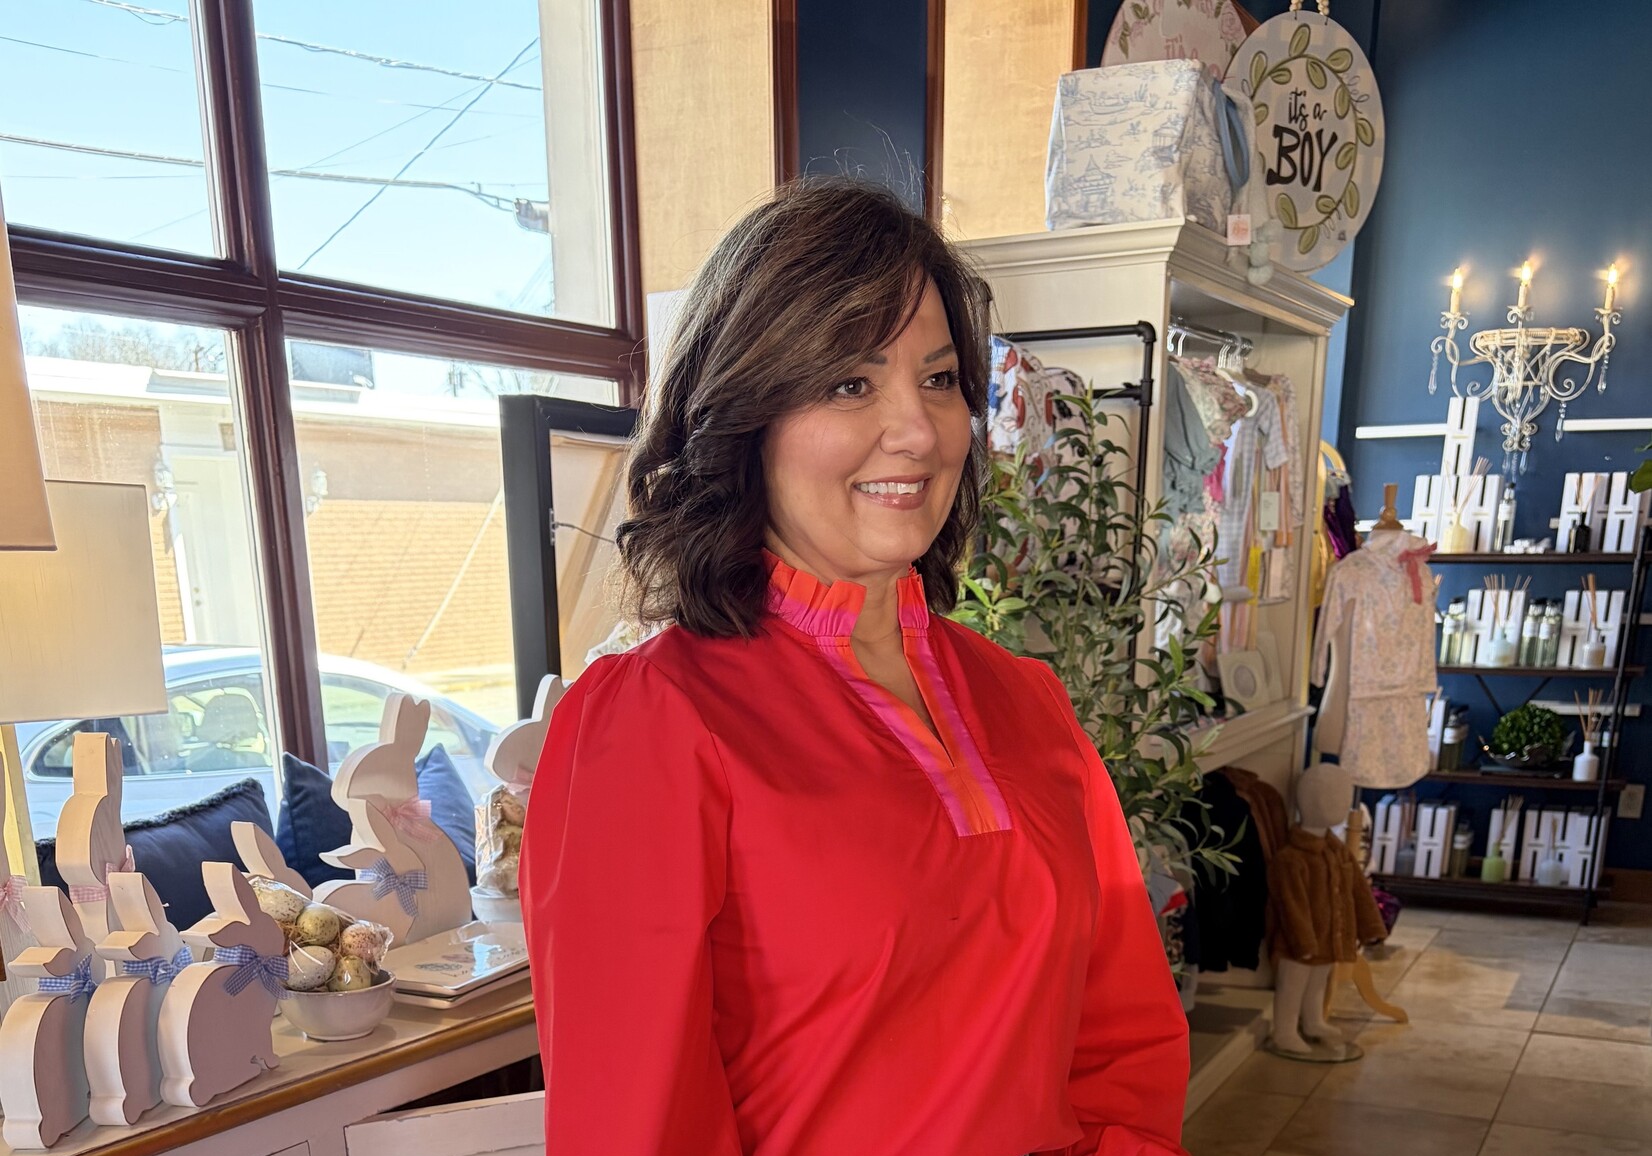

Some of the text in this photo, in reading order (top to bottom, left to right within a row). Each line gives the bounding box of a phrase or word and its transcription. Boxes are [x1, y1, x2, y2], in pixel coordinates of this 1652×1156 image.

[1288, 87, 1327, 132] it's a
[1266, 123, 1338, 192] BOY
